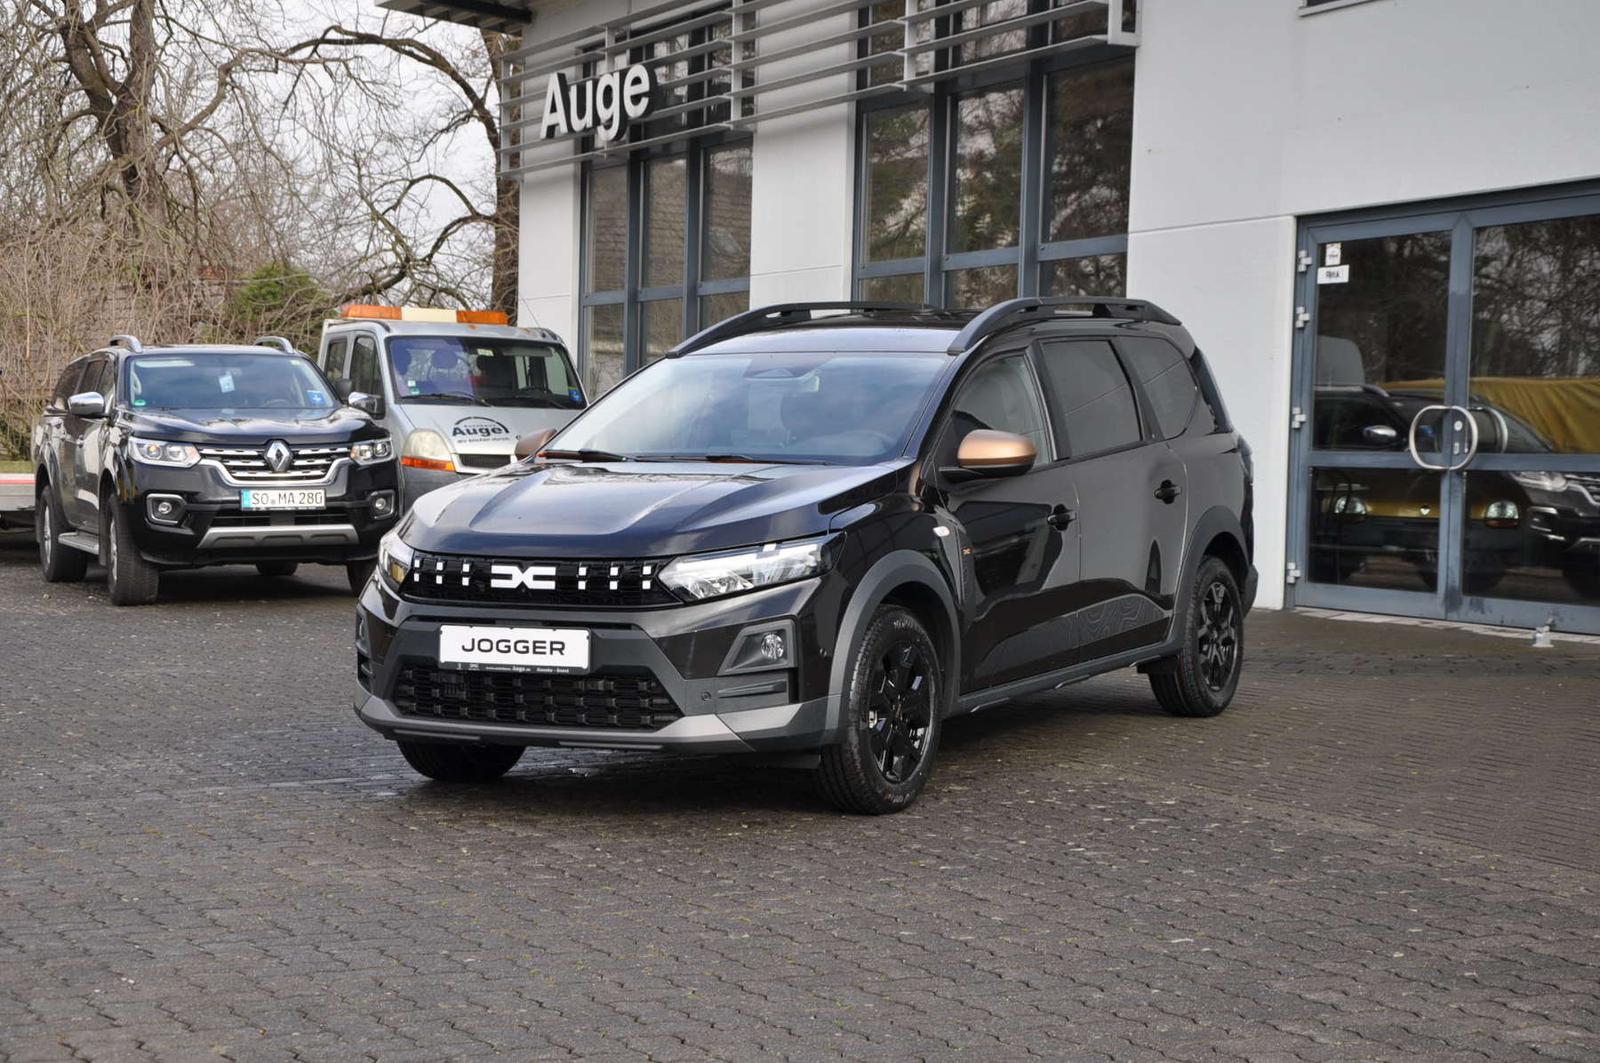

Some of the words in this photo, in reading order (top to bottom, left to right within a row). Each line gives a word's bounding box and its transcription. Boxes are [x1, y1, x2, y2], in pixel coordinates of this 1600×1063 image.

[540, 64, 650, 141] Auge
[252, 492, 269, 505] SO
[278, 492, 295, 505] MA
[461, 638, 566, 655] JOGGER
